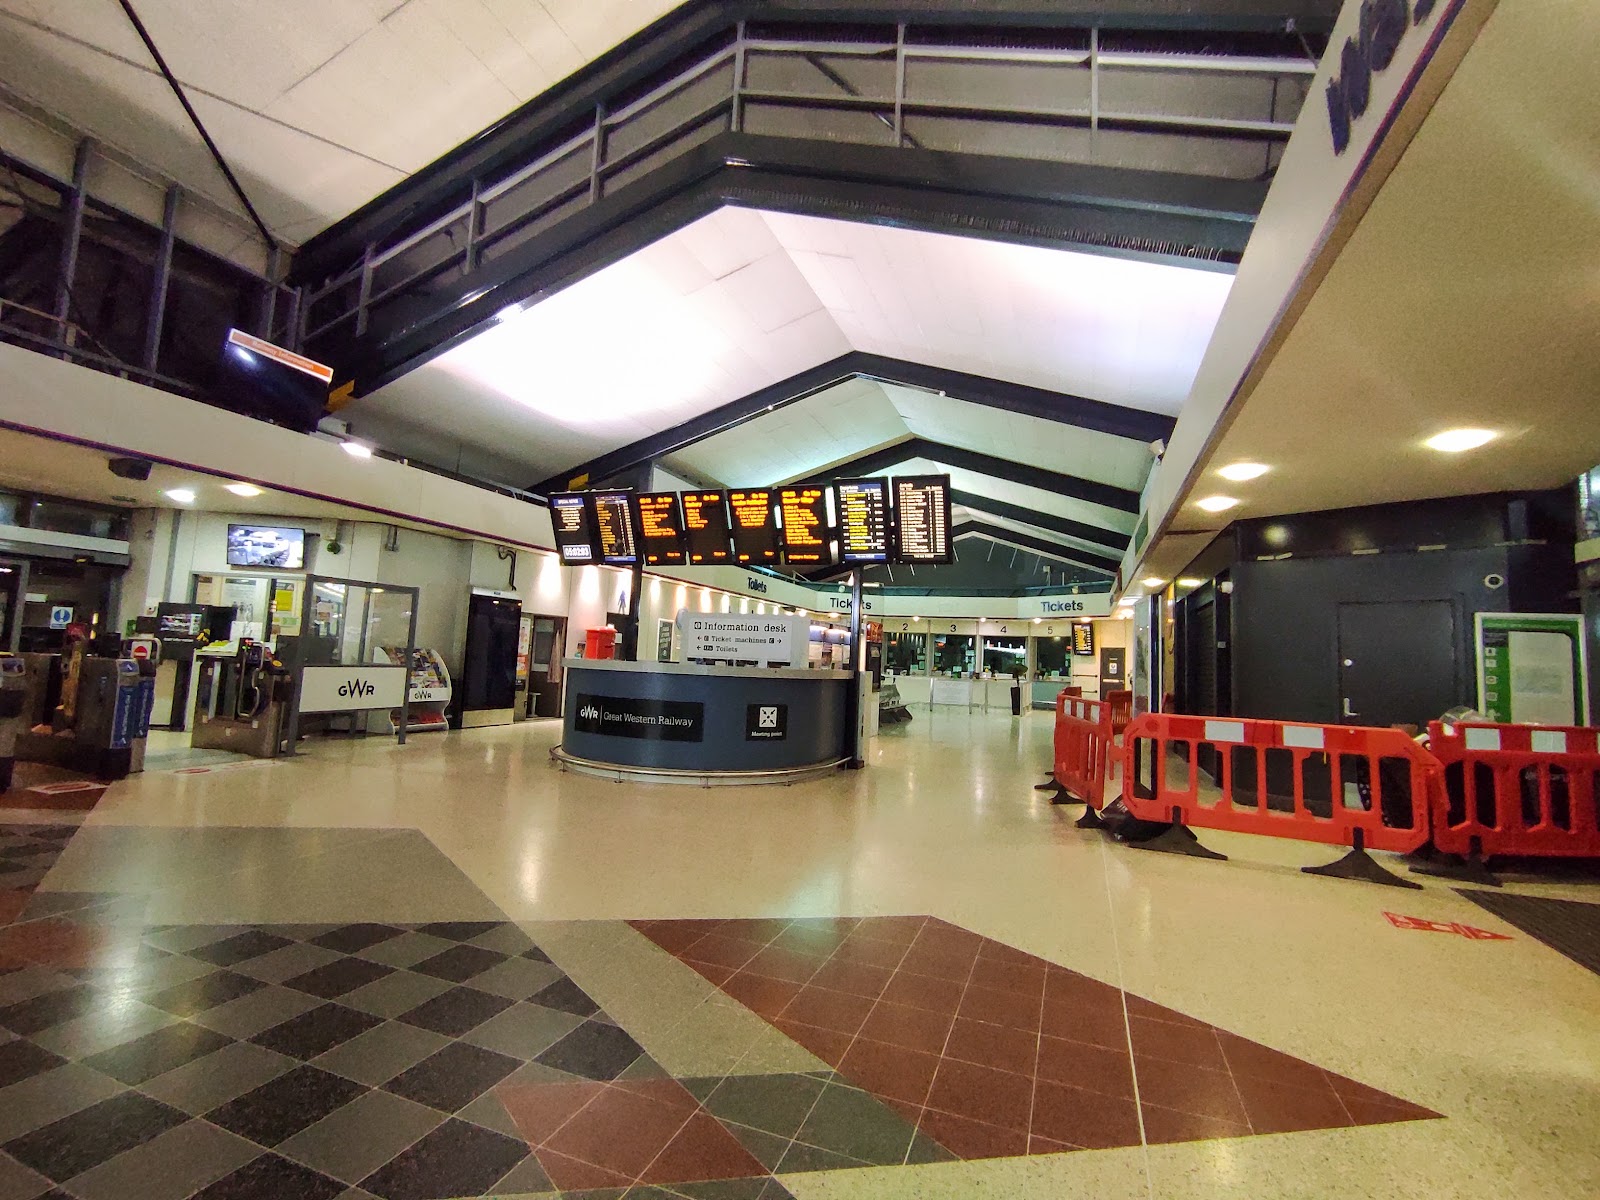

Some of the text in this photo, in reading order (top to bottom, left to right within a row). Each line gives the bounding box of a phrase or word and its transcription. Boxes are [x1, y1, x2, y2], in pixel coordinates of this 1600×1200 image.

[748, 577, 767, 593] Toilets
[830, 598, 872, 609] Tickts
[1041, 600, 1084, 612] Tickets
[704, 621, 787, 633] Information desk
[902, 623, 909, 631] 2
[950, 624, 957, 633] 3
[1000, 625, 1007, 634] 4
[1047, 626, 1053, 634] 5
[338, 678, 374, 698] GWR
[415, 690, 431, 699] GWR
[580, 704, 694, 728] GWR Great Western Railway
